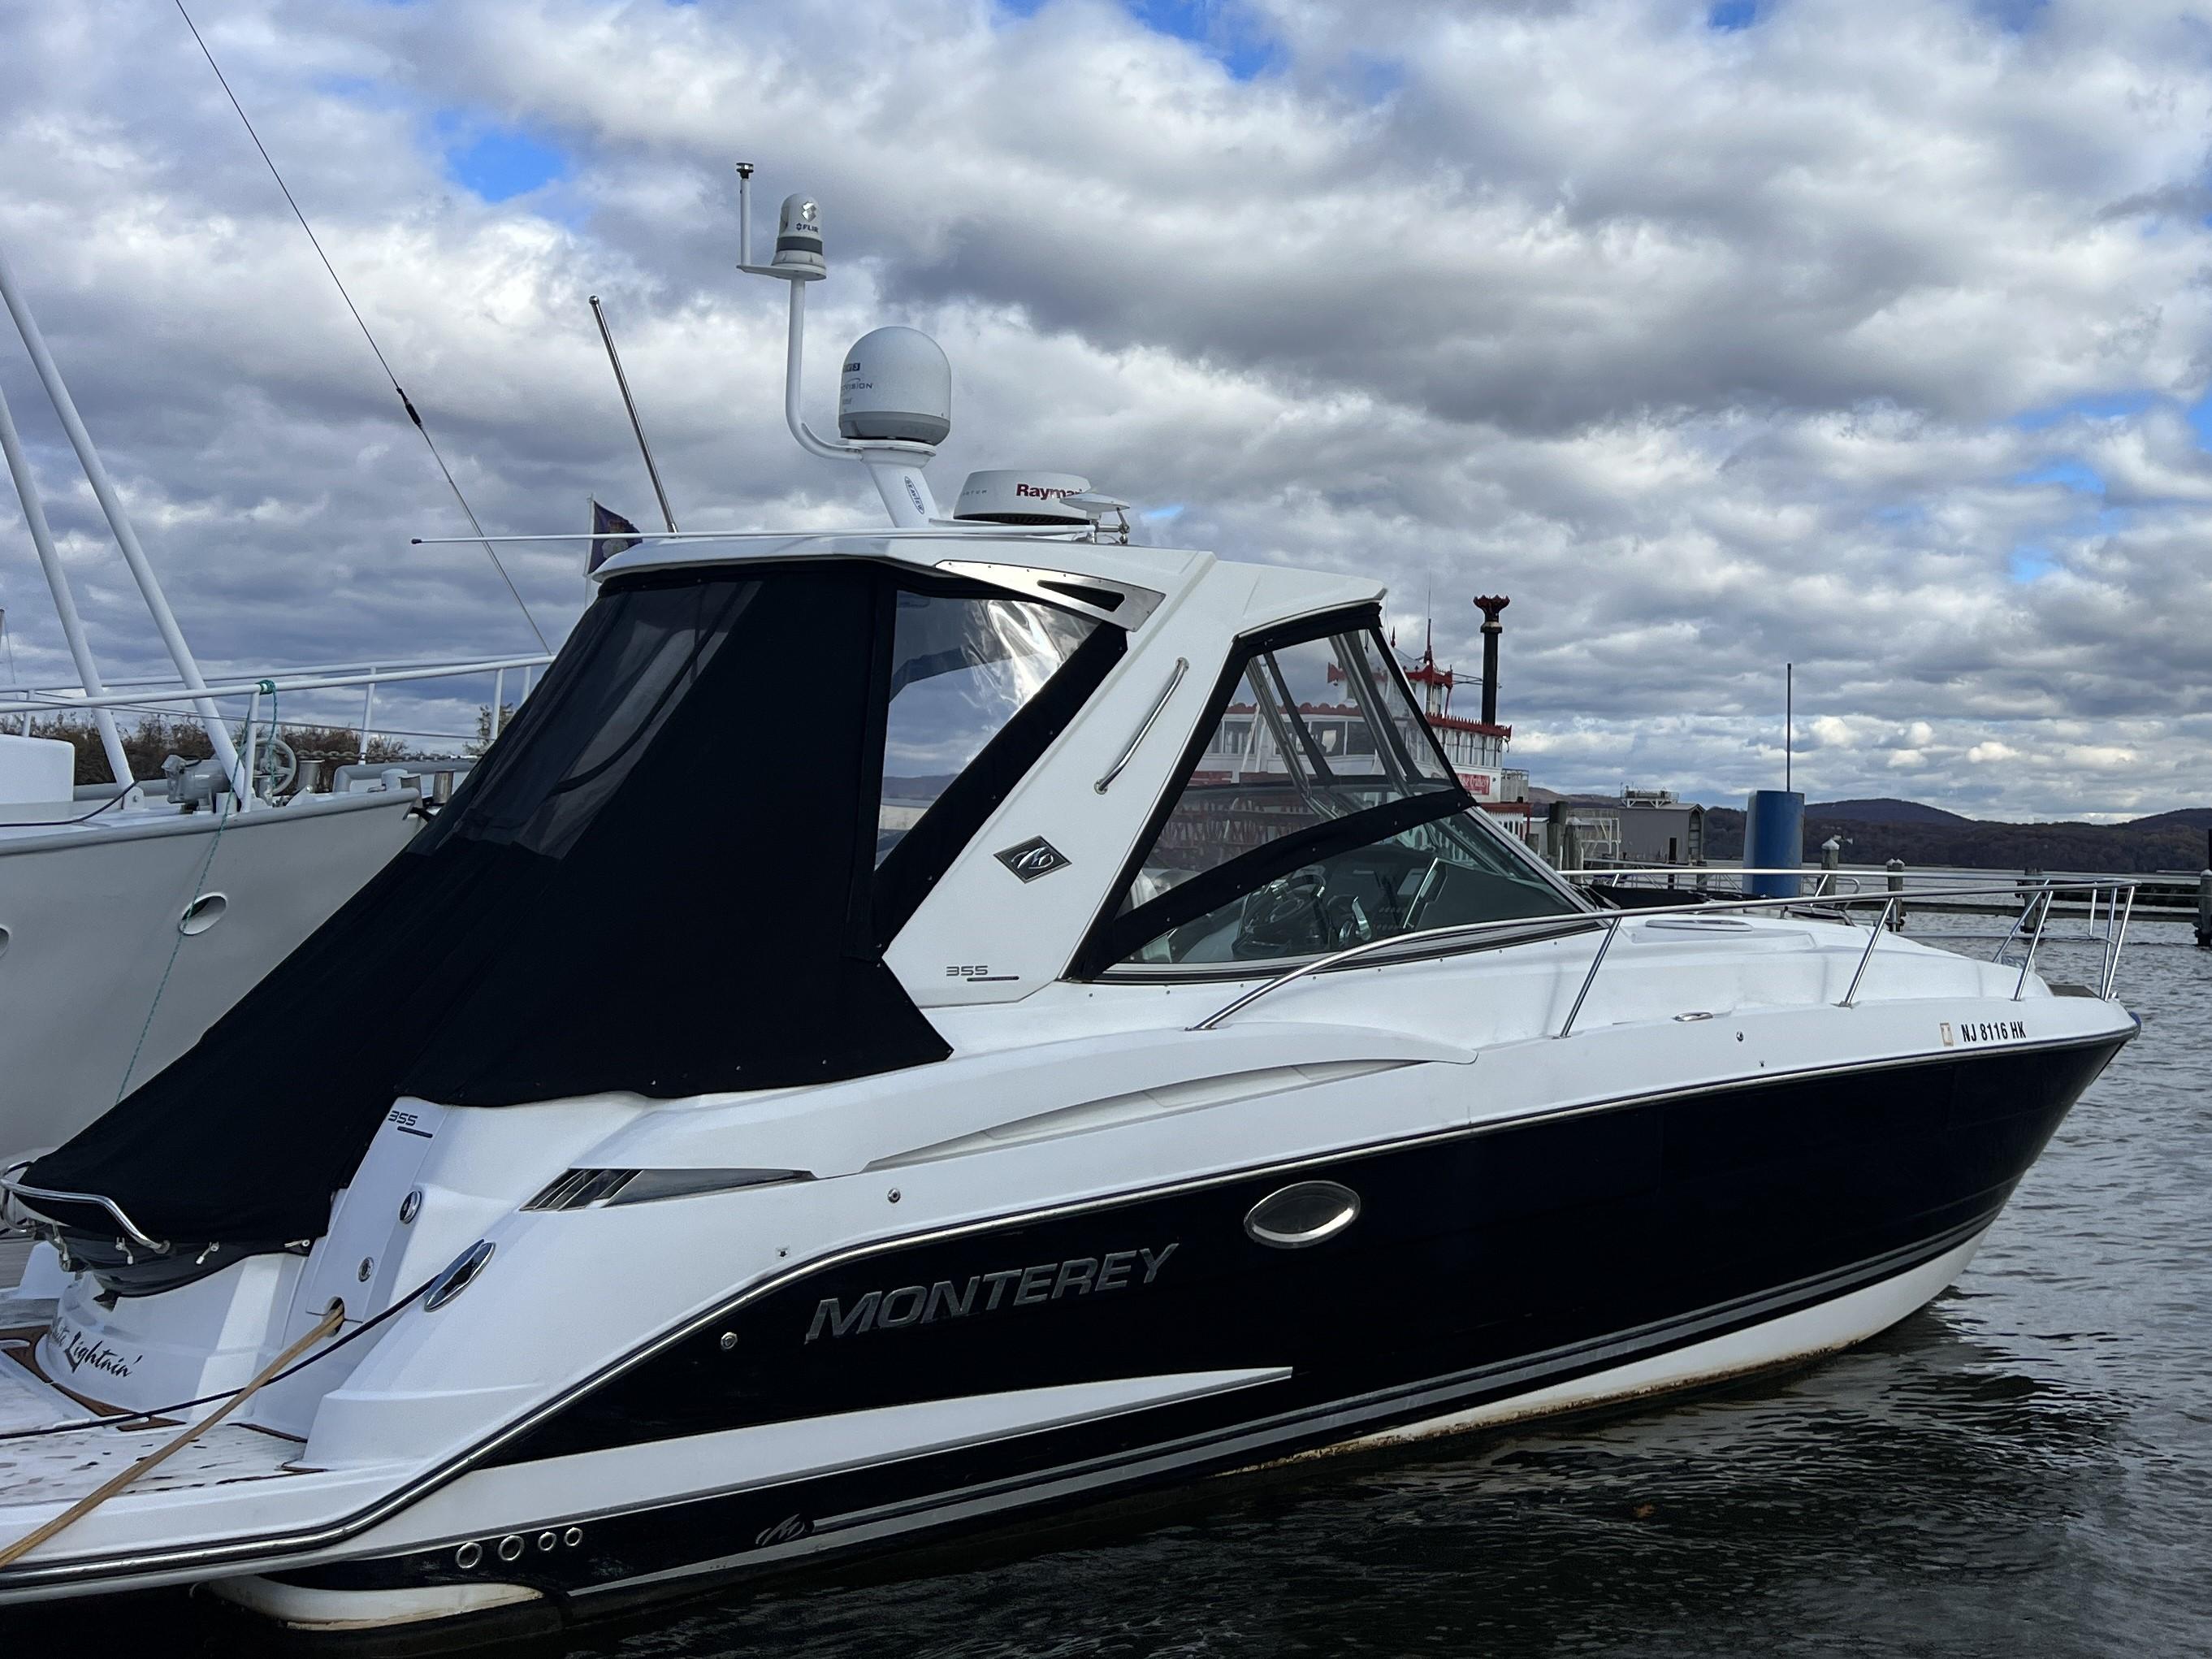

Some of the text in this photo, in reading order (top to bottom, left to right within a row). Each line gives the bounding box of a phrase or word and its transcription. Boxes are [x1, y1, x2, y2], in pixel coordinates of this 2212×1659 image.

[946, 965, 989, 977] 355
[1961, 1021, 2027, 1042] NJ 8116 HK
[387, 1110, 418, 1126] 355
[803, 1243, 1180, 1345] MONTEREY
